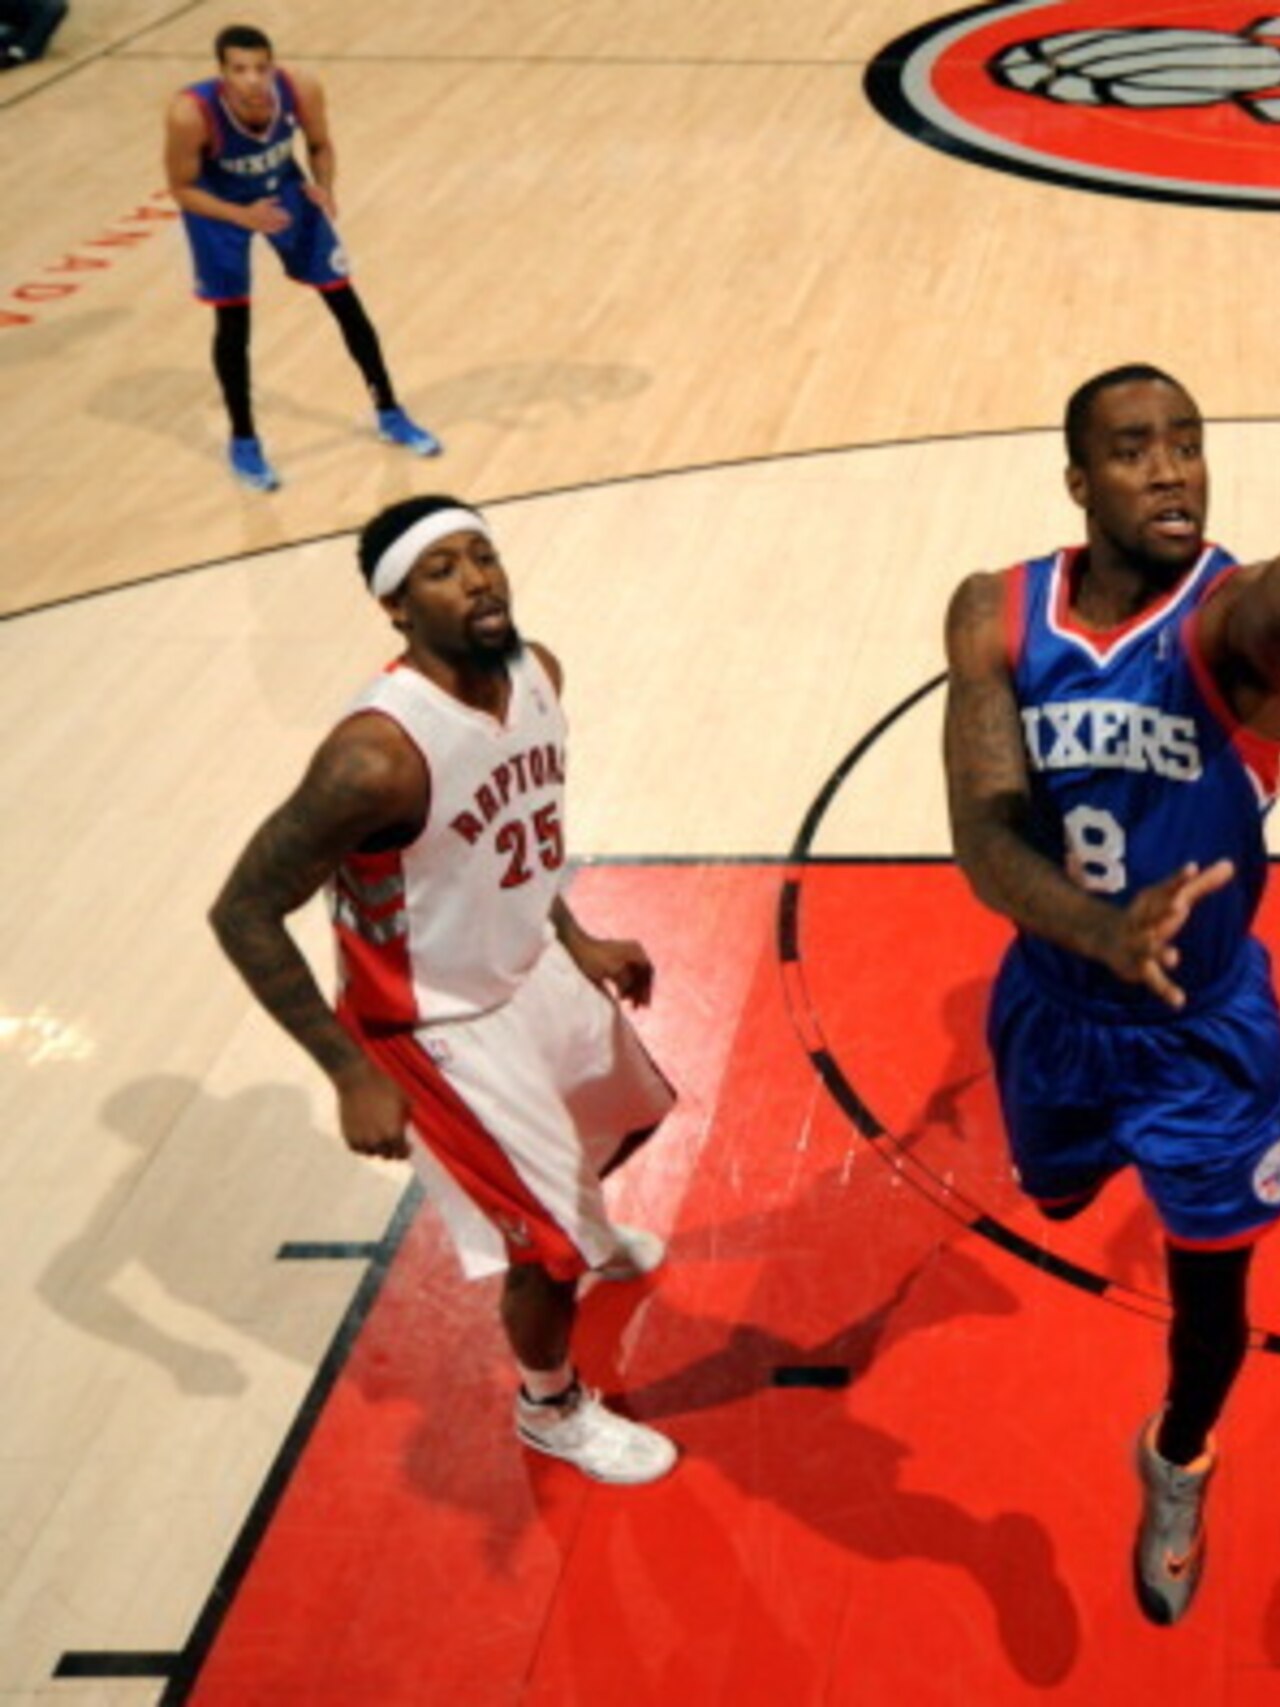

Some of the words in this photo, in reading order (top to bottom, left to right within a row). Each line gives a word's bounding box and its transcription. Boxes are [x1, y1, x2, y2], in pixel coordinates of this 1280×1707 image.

[1021, 699, 1202, 781] IXERS
[449, 741, 566, 846] RAPTOR
[495, 802, 566, 889] 25
[1063, 805, 1126, 893] 8
